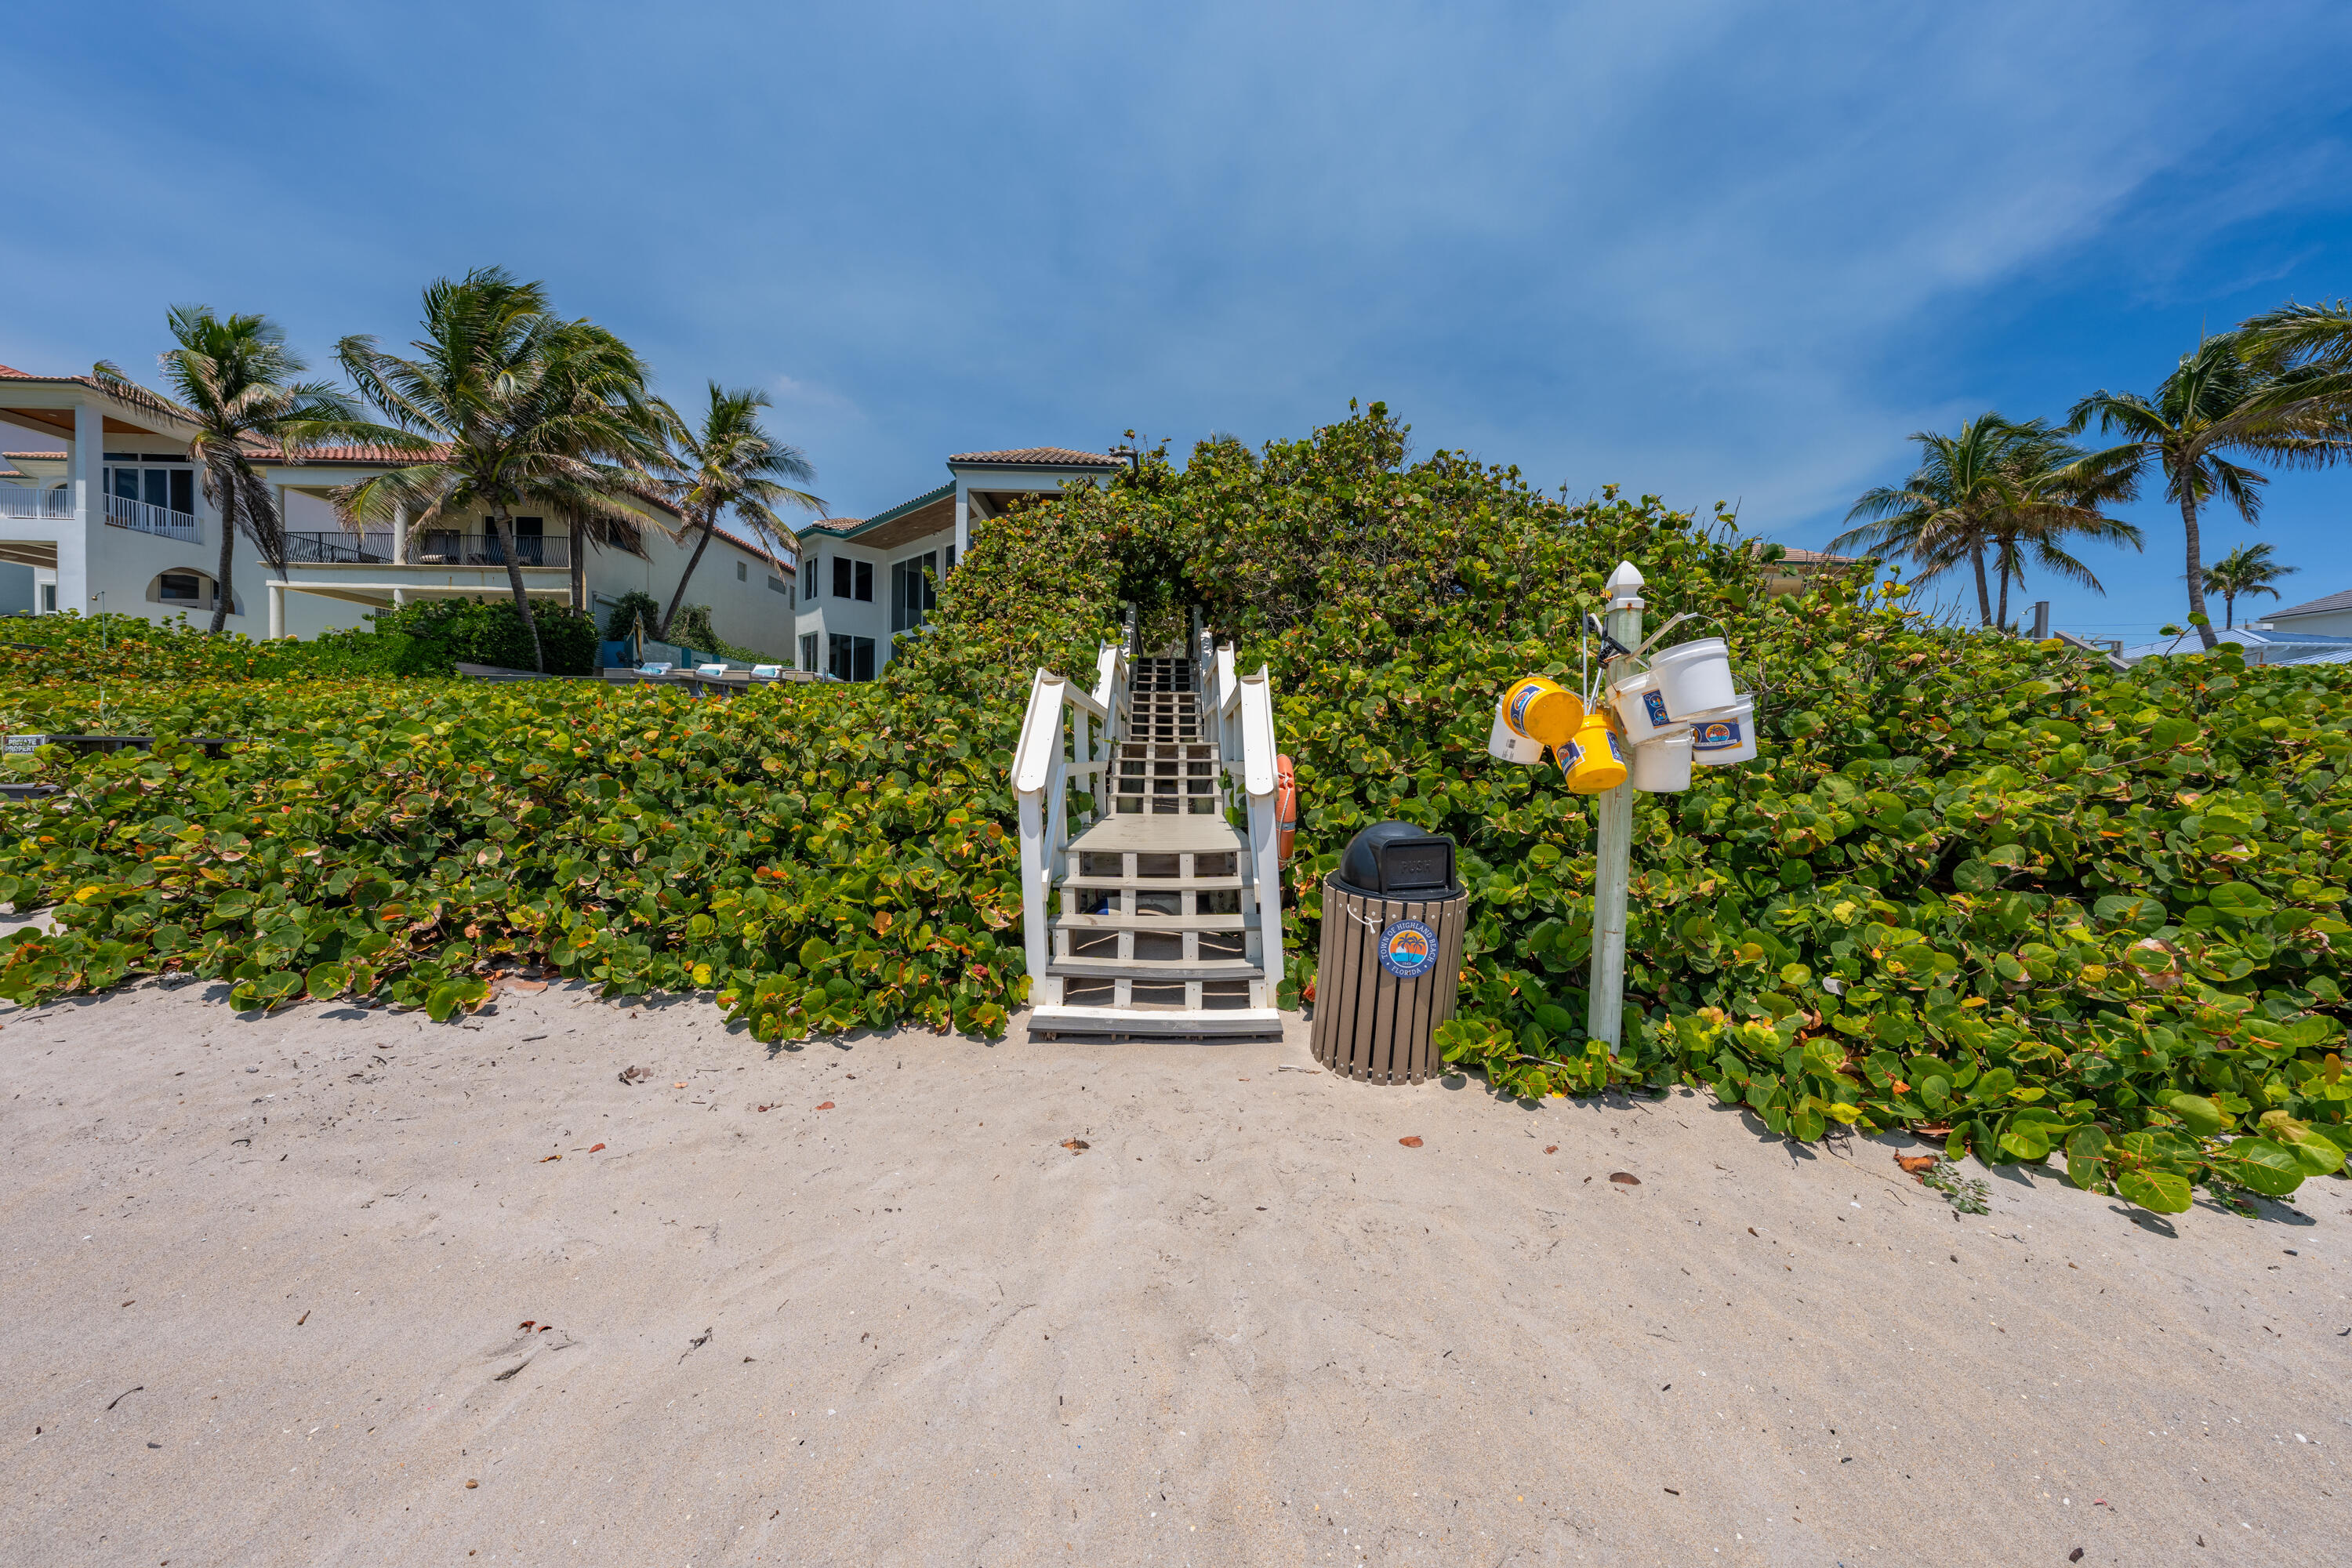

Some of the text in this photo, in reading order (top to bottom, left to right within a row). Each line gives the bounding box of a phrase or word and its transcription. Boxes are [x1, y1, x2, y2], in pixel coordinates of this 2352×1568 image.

[1400, 859, 1432, 873] PUSH
[1388, 927, 1396, 936] OF
[1397, 922, 1432, 938] HIGHLAND
[1427, 938, 1436, 963] BEACH
[1391, 966, 1421, 976] FLORIDA
